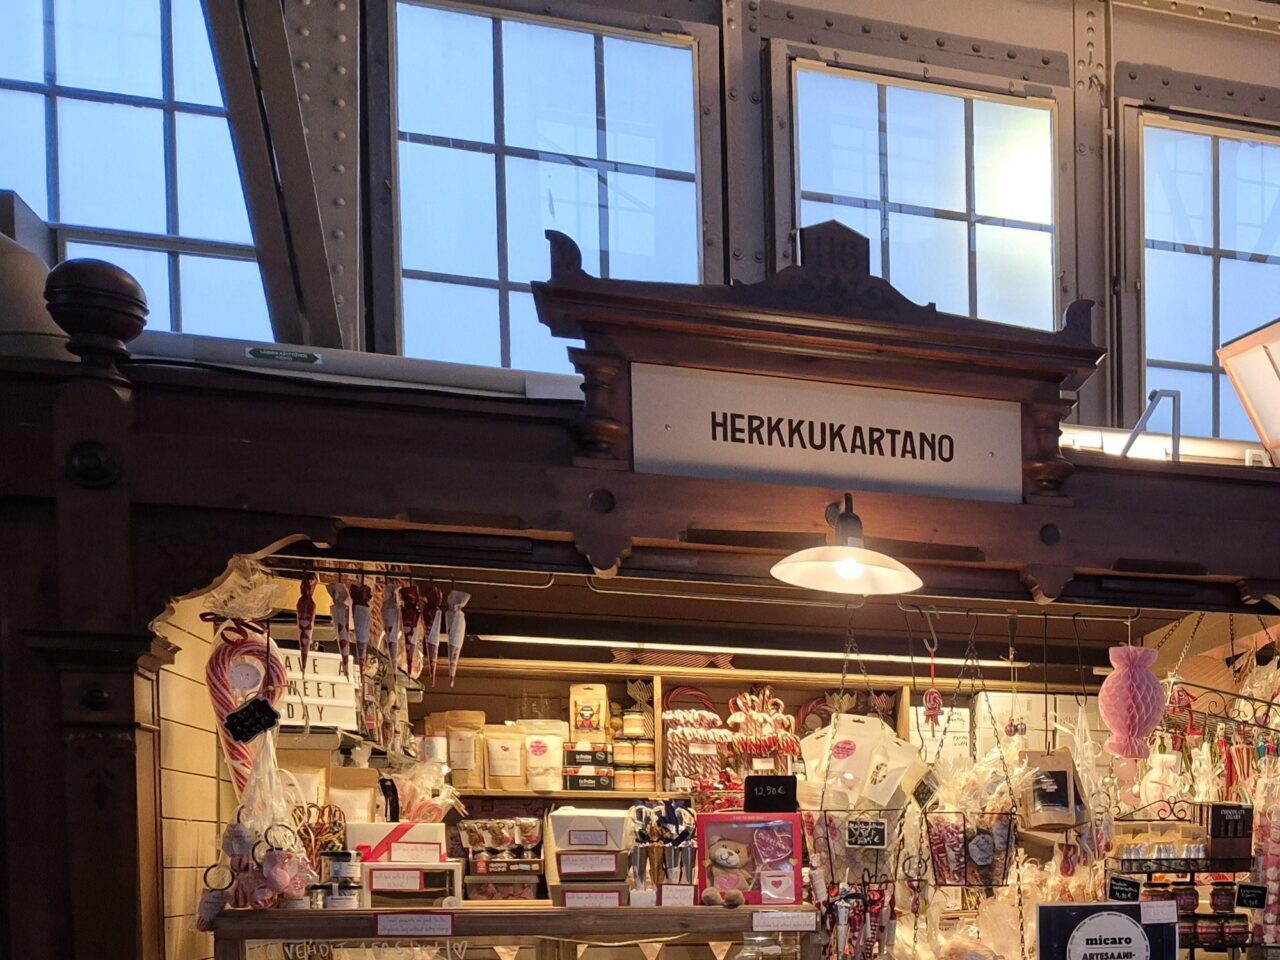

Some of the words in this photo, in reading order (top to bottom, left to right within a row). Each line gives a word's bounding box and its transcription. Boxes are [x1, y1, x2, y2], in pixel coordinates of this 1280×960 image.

[710, 410, 955, 463] HERKKUKARTANO
[286, 680, 336, 698] WEET
[1085, 935, 1133, 946] micaro
[1082, 951, 1136, 960] ARTESAANI-
